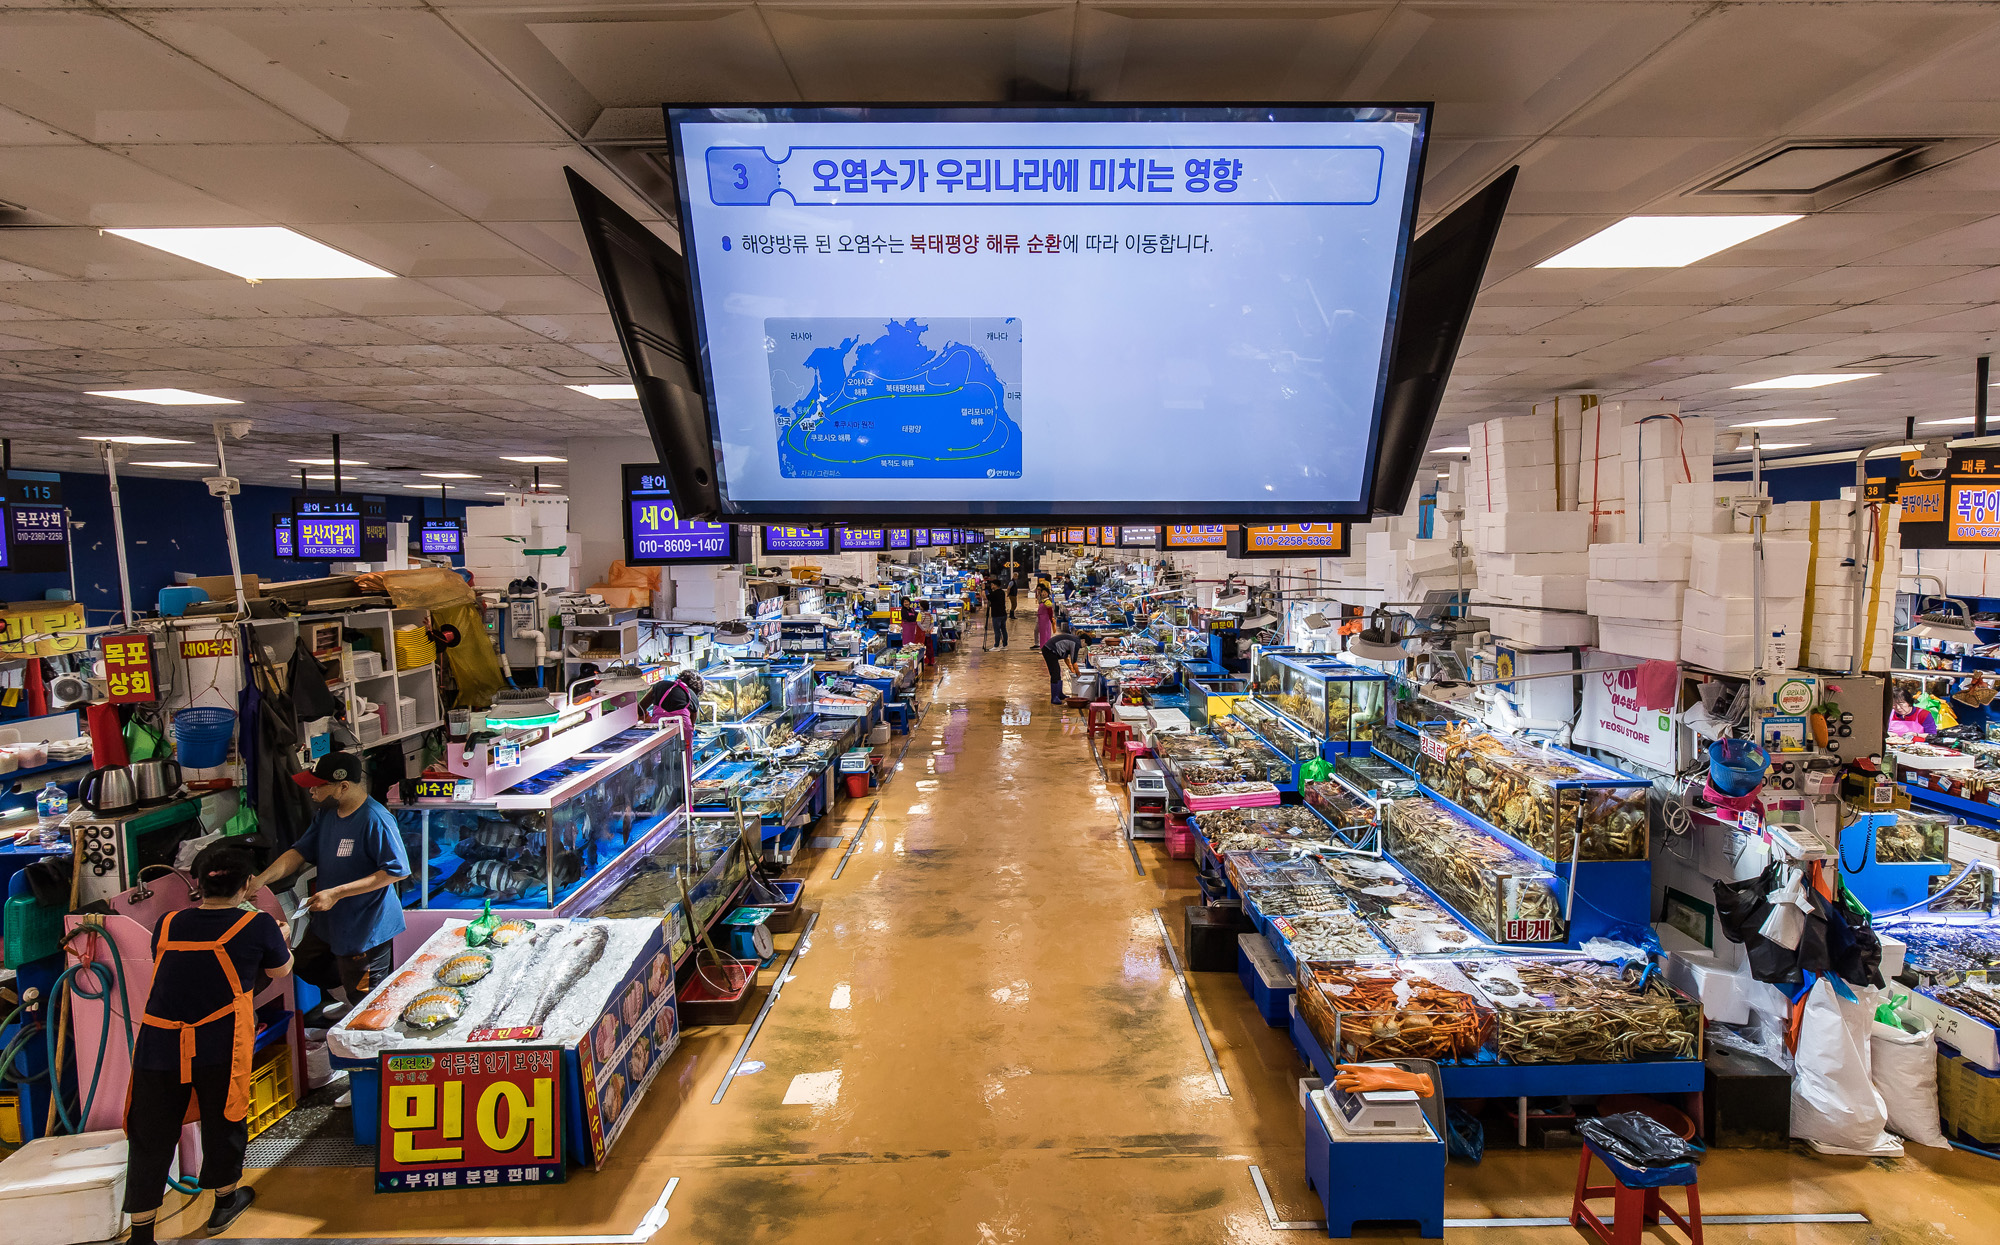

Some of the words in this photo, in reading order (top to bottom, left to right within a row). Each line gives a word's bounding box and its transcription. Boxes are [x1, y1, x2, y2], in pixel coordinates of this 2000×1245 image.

[732, 163, 749, 190] 3
[813, 159, 929, 193] 오염수가
[936, 159, 1079, 193] 우리나라에
[1089, 158, 1175, 193] 미치는
[1184, 158, 1243, 193] 영향
[742, 234, 809, 254] 해양방류
[815, 234, 831, 253] 된
[837, 234, 905, 254] 오염수는
[910, 234, 979, 254] 북태평양
[986, 234, 1021, 254] 해류
[1026, 234, 1078, 254] 순환에
[1085, 234, 1119, 253] 따라
[1125, 234, 1213, 253] 이동합니다.
[790, 332, 812, 341] 러시아
[986, 332, 1008, 341] 캐나다
[1007, 391, 1022, 400] 미국
[961, 408, 994, 416] 캘리포니아
[777, 417, 791, 426] 한국
[801, 422, 816, 431] 일본
[1961, 459, 1987, 474] 패류
[641, 475, 666, 489] 활어
[23, 485, 51, 499] 115
[334, 503, 354, 512] 114
[369, 505, 382, 514] 114
[16, 511, 62, 528] 목포상회
[17, 532, 63, 541] 010-2360-2258
[302, 524, 355, 545] 부산자갈치
[425, 532, 457, 543] 전북임실
[1957, 526, 2000, 537] 010-627
[639, 538, 725, 553] 010-8609-1407
[1255, 536, 1332, 547] 010-2258-5362
[105, 642, 149, 667] 목포
[183, 640, 233, 657] 세아수산
[109, 670, 151, 696] 상회
[1600, 719, 1625, 735] YEOSU
[1625, 727, 1650, 744] STORE
[1506, 919, 1551, 941] 대게
[393, 1057, 432, 1070] 자연산
[440, 1052, 480, 1076] 여름철
[484, 1052, 510, 1074] 인기
[513, 1051, 553, 1073] 보양식
[394, 1071, 429, 1083] 국내산
[584, 1061, 604, 1161] 세아수산
[388, 1077, 554, 1163] 민어
[405, 1171, 457, 1188] 부위별
[465, 1169, 499, 1184] 분할
[507, 1167, 540, 1182] 판매
